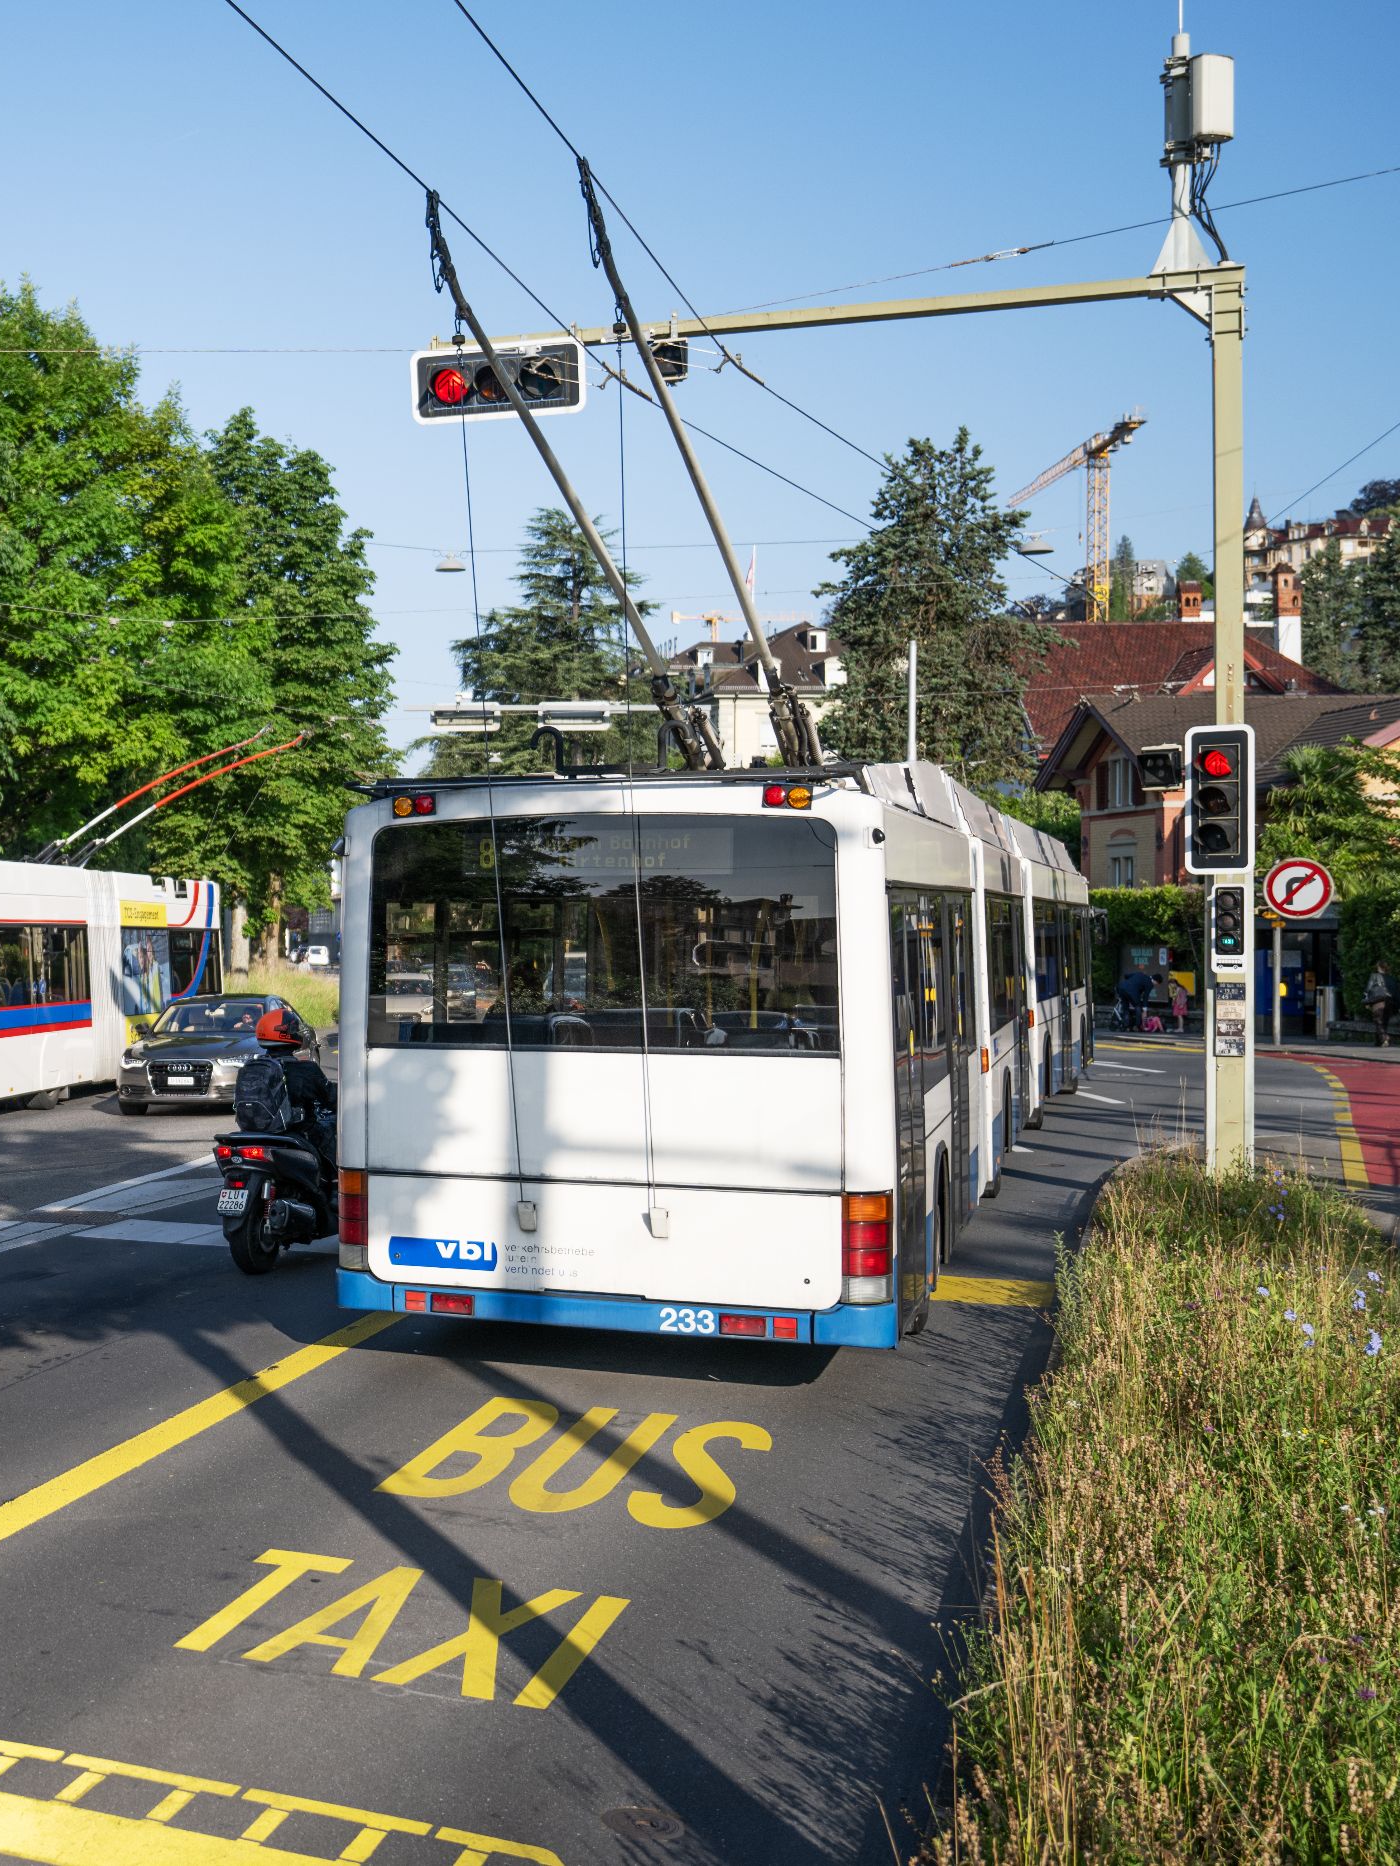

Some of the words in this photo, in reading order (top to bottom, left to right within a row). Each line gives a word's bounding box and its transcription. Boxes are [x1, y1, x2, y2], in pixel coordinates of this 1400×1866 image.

[480, 838, 494, 869] 8
[219, 1200, 244, 1210] 22286
[228, 1190, 239, 1200] LU
[435, 1240, 492, 1262] vbl
[505, 1244, 595, 1257] vekehrsbetriebe
[505, 1265, 554, 1277] verbndet
[558, 1269, 578, 1278] us
[660, 1307, 715, 1334] 233
[375, 1397, 771, 1528] BUS
[175, 1549, 630, 1709] TAXI
